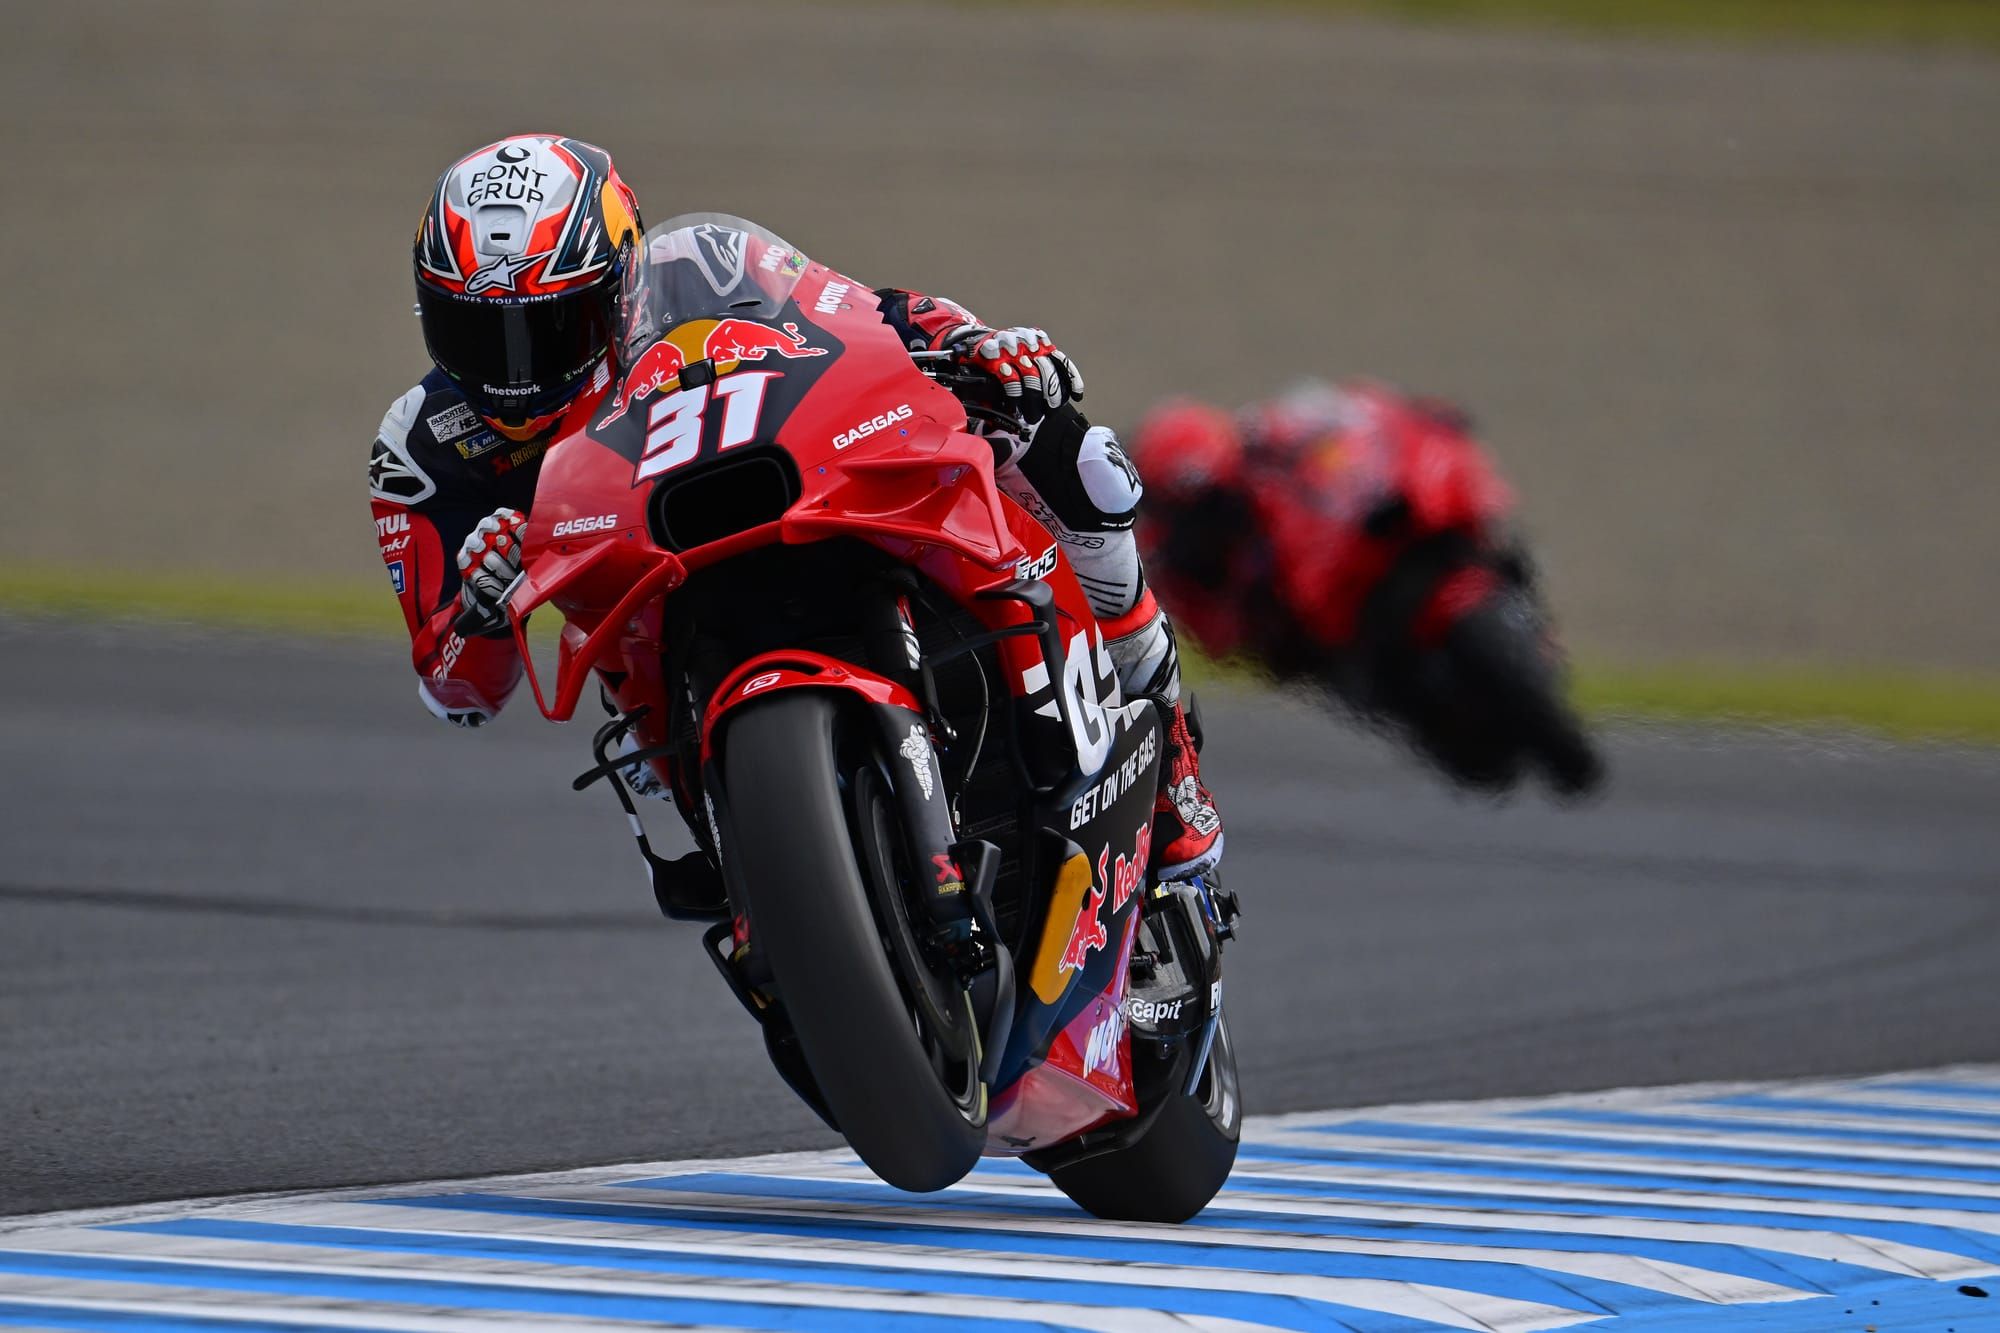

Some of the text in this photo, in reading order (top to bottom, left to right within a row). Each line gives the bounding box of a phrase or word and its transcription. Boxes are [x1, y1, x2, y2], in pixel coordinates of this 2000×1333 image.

[470, 165, 548, 188] FONT
[467, 182, 544, 207] GRUP
[452, 293, 560, 305] GIVES YOU WINGS
[814, 280, 850, 315] MOTUL
[482, 383, 542, 397] finetwork
[431, 404, 470, 426] SUPERTEC
[832, 403, 913, 451] GASGAS
[635, 369, 786, 487] 31
[375, 512, 411, 537] TUL
[552, 514, 618, 537] GASGAS
[1016, 543, 1058, 580] ECH3
[1070, 726, 1156, 831] GET ON THE GAS!
